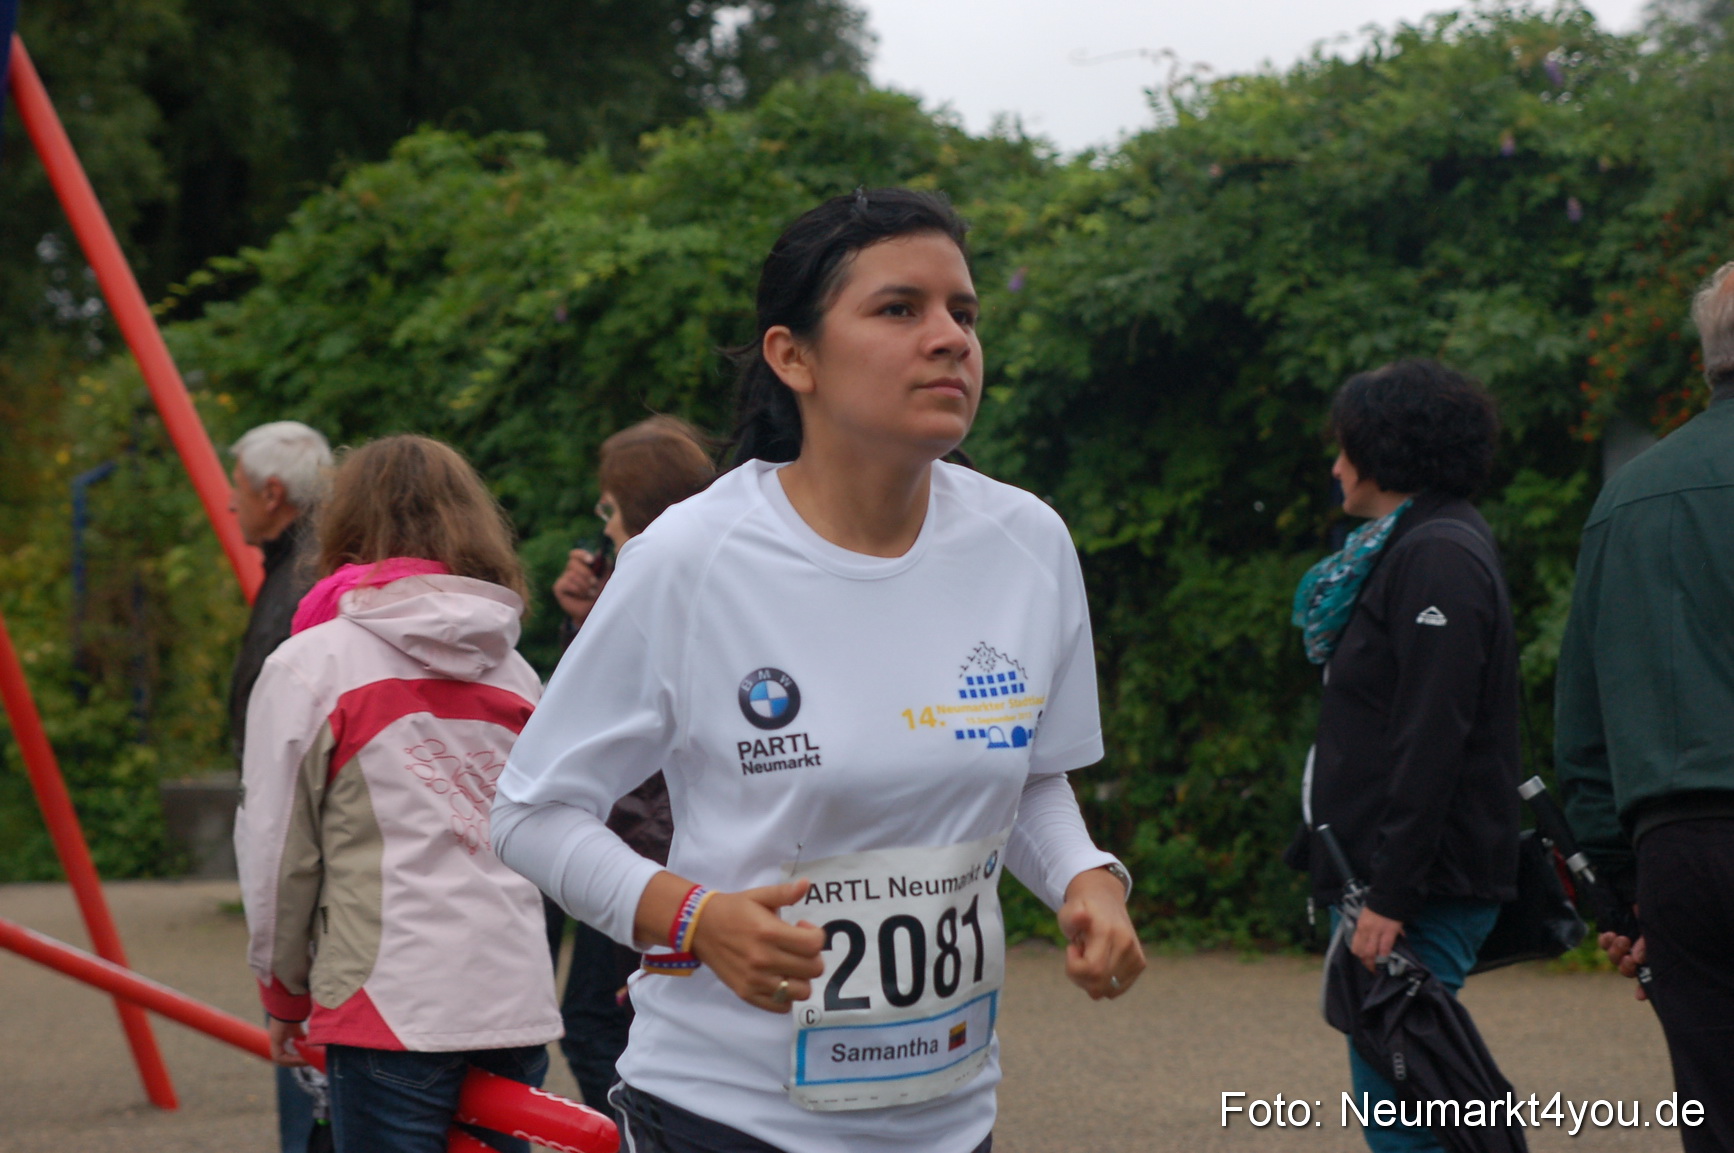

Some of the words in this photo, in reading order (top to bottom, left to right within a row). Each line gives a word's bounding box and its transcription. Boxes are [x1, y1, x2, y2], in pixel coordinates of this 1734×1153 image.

[741, 669, 793, 692] BMW
[901, 706, 946, 730] 14.
[936, 701, 1006, 715] Neumarkter
[737, 732, 819, 760] PARTL
[741, 753, 822, 776] Neumarkt
[803, 878, 881, 905] ARTL
[888, 863, 982, 899] Neumarkt
[820, 893, 985, 1012] 2081
[805, 1008, 816, 1025] C
[830, 1036, 940, 1063] Samantha
